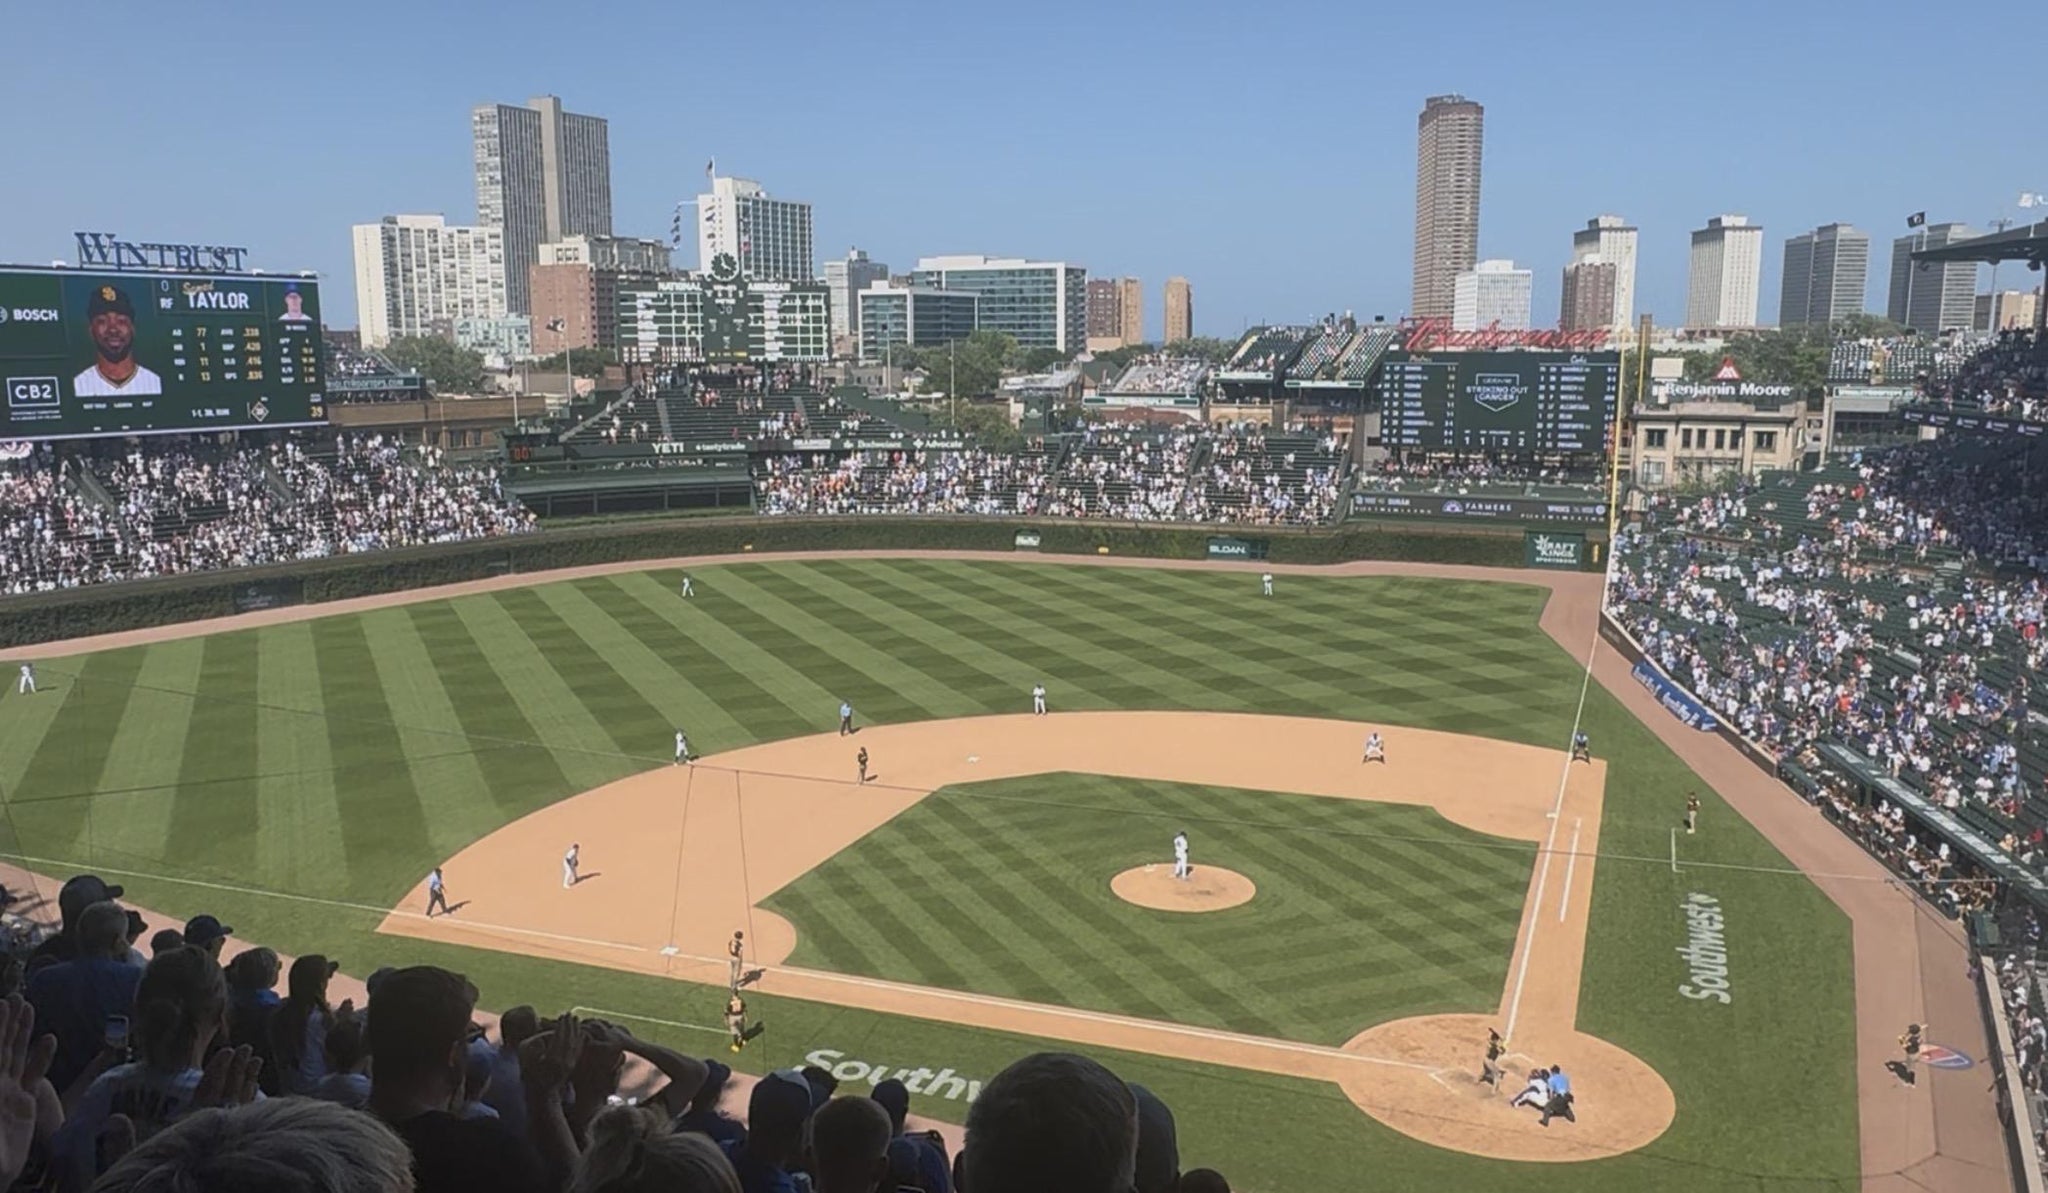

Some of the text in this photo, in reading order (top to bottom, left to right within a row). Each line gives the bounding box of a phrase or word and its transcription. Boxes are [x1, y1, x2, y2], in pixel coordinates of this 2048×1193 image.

[74, 232, 248, 272] WINTRUST
[188, 291, 250, 309] TAYLOR
[13, 308, 59, 322] BOSCH
[14, 384, 53, 399] CB2
[1479, 393, 1515, 401] CANCER
[1665, 382, 1793, 398] Benjamin Moore
[652, 442, 685, 453] YETI
[1465, 502, 1512, 512] FARMERS
[1540, 542, 1577, 552] DRAFT
[1540, 550, 1575, 558] KINGS
[1675, 903, 1731, 1004] Southwest
